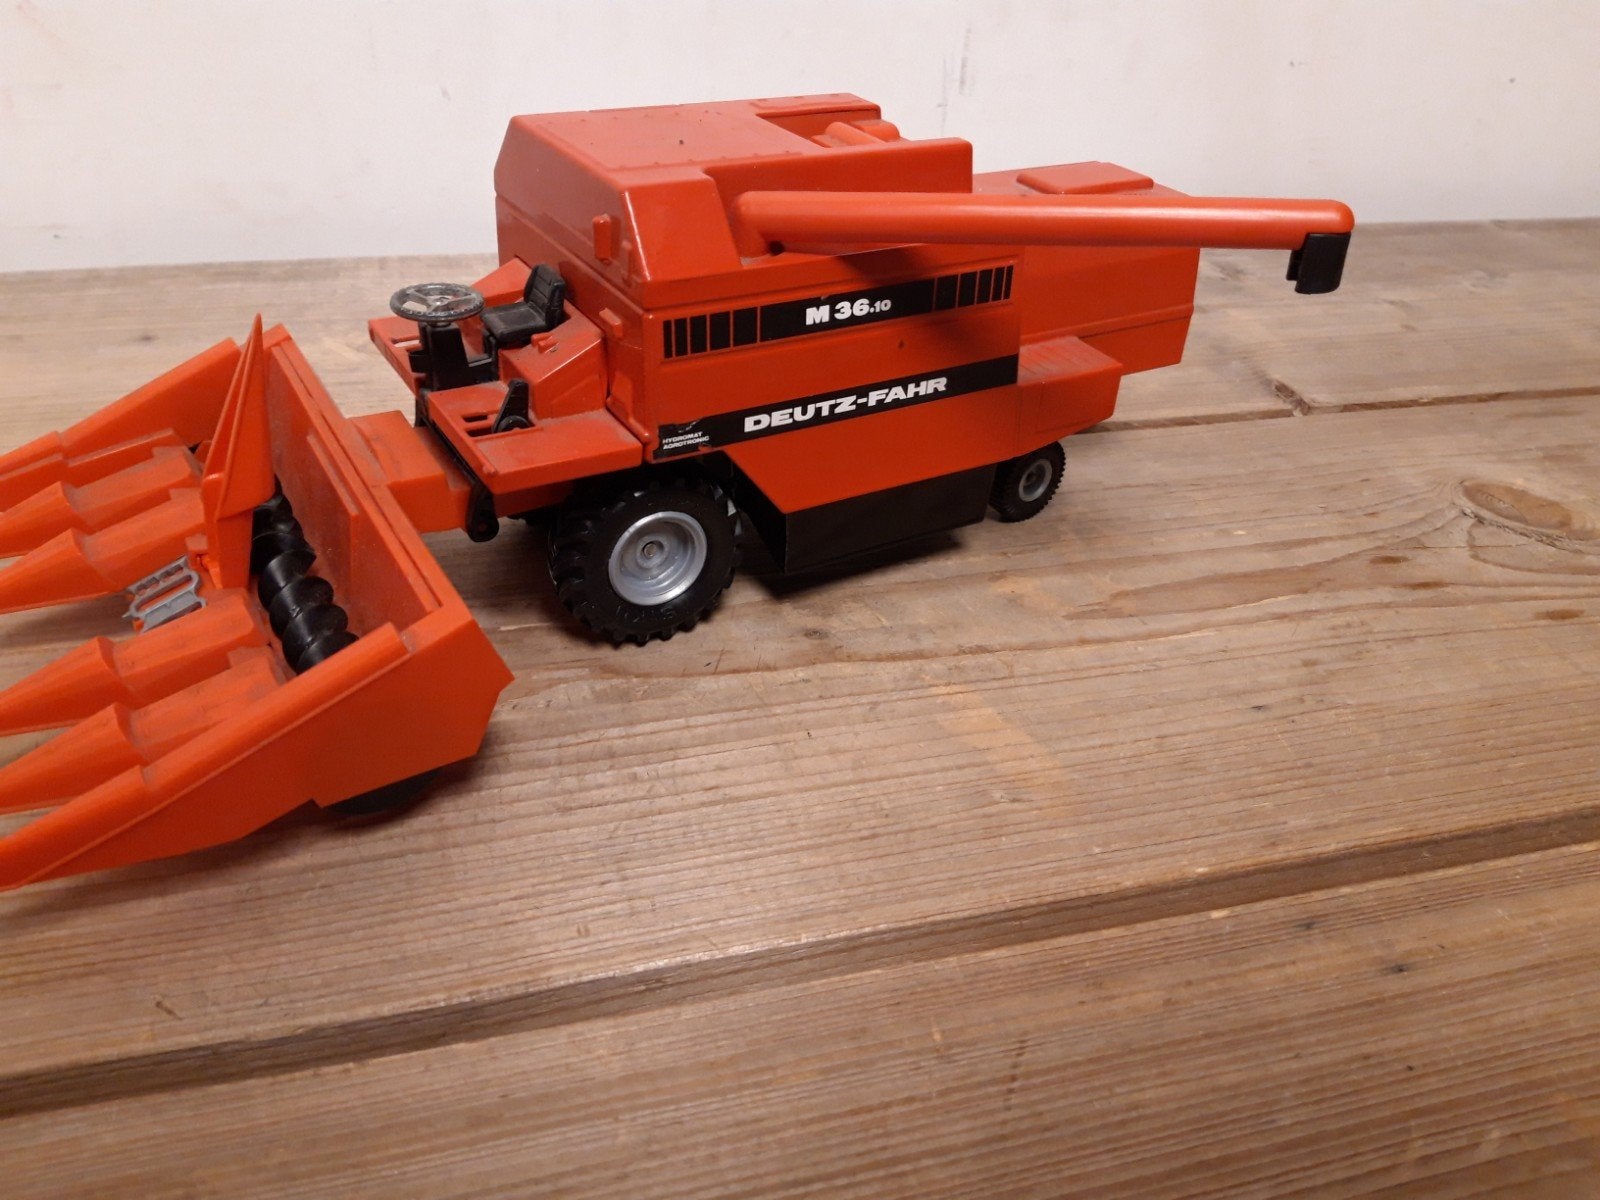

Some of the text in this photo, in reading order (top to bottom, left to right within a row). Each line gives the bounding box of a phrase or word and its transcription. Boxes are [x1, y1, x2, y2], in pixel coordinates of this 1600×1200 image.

[805, 298, 892, 326] M 36.10
[743, 376, 948, 433] DEUTZ-FAHR
[662, 431, 703, 444] HYDROMAT
[663, 435, 710, 450] AGROTRONIC
